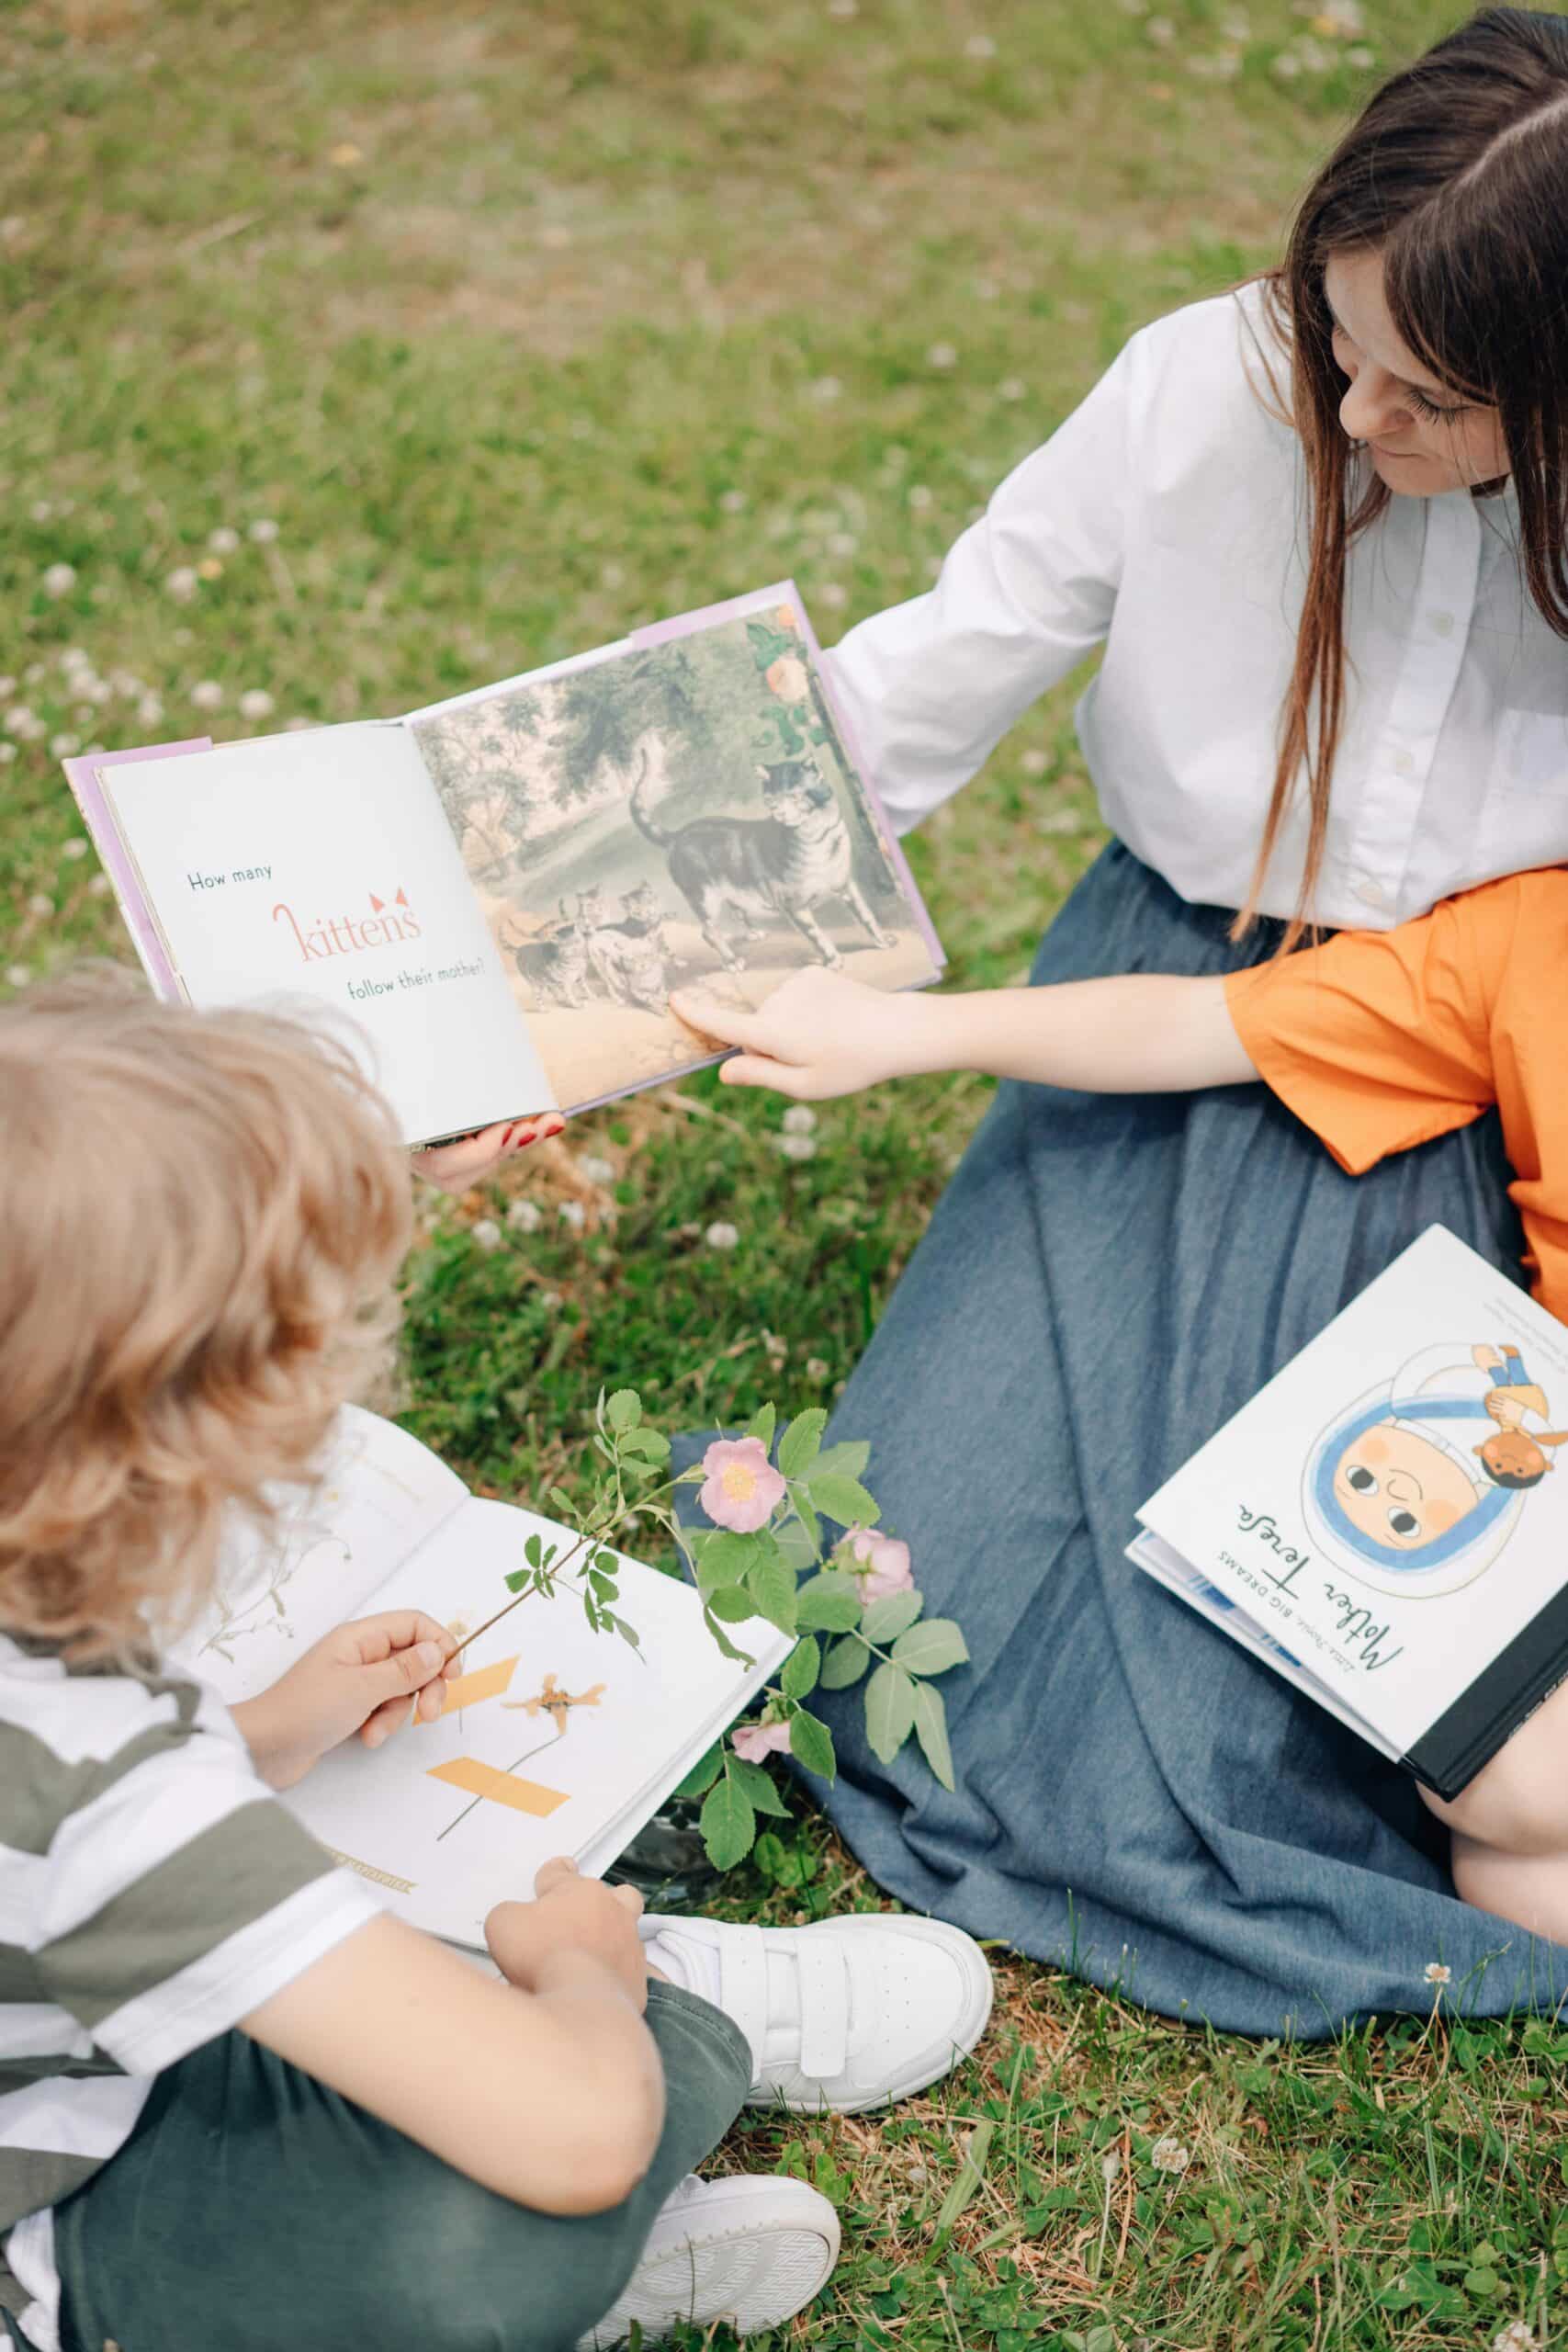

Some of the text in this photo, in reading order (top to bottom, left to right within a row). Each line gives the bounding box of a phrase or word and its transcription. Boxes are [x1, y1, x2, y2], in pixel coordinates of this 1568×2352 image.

[187, 865, 272, 891] How many
[272, 902, 422, 963] kittens
[347, 980, 394, 1001] follow
[398, 968, 434, 989] their
[1218, 1551, 1269, 1598] DREAMS
[1237, 1504, 1404, 1670] Mother Teresa
[1269, 1597, 1293, 1618] BIG
